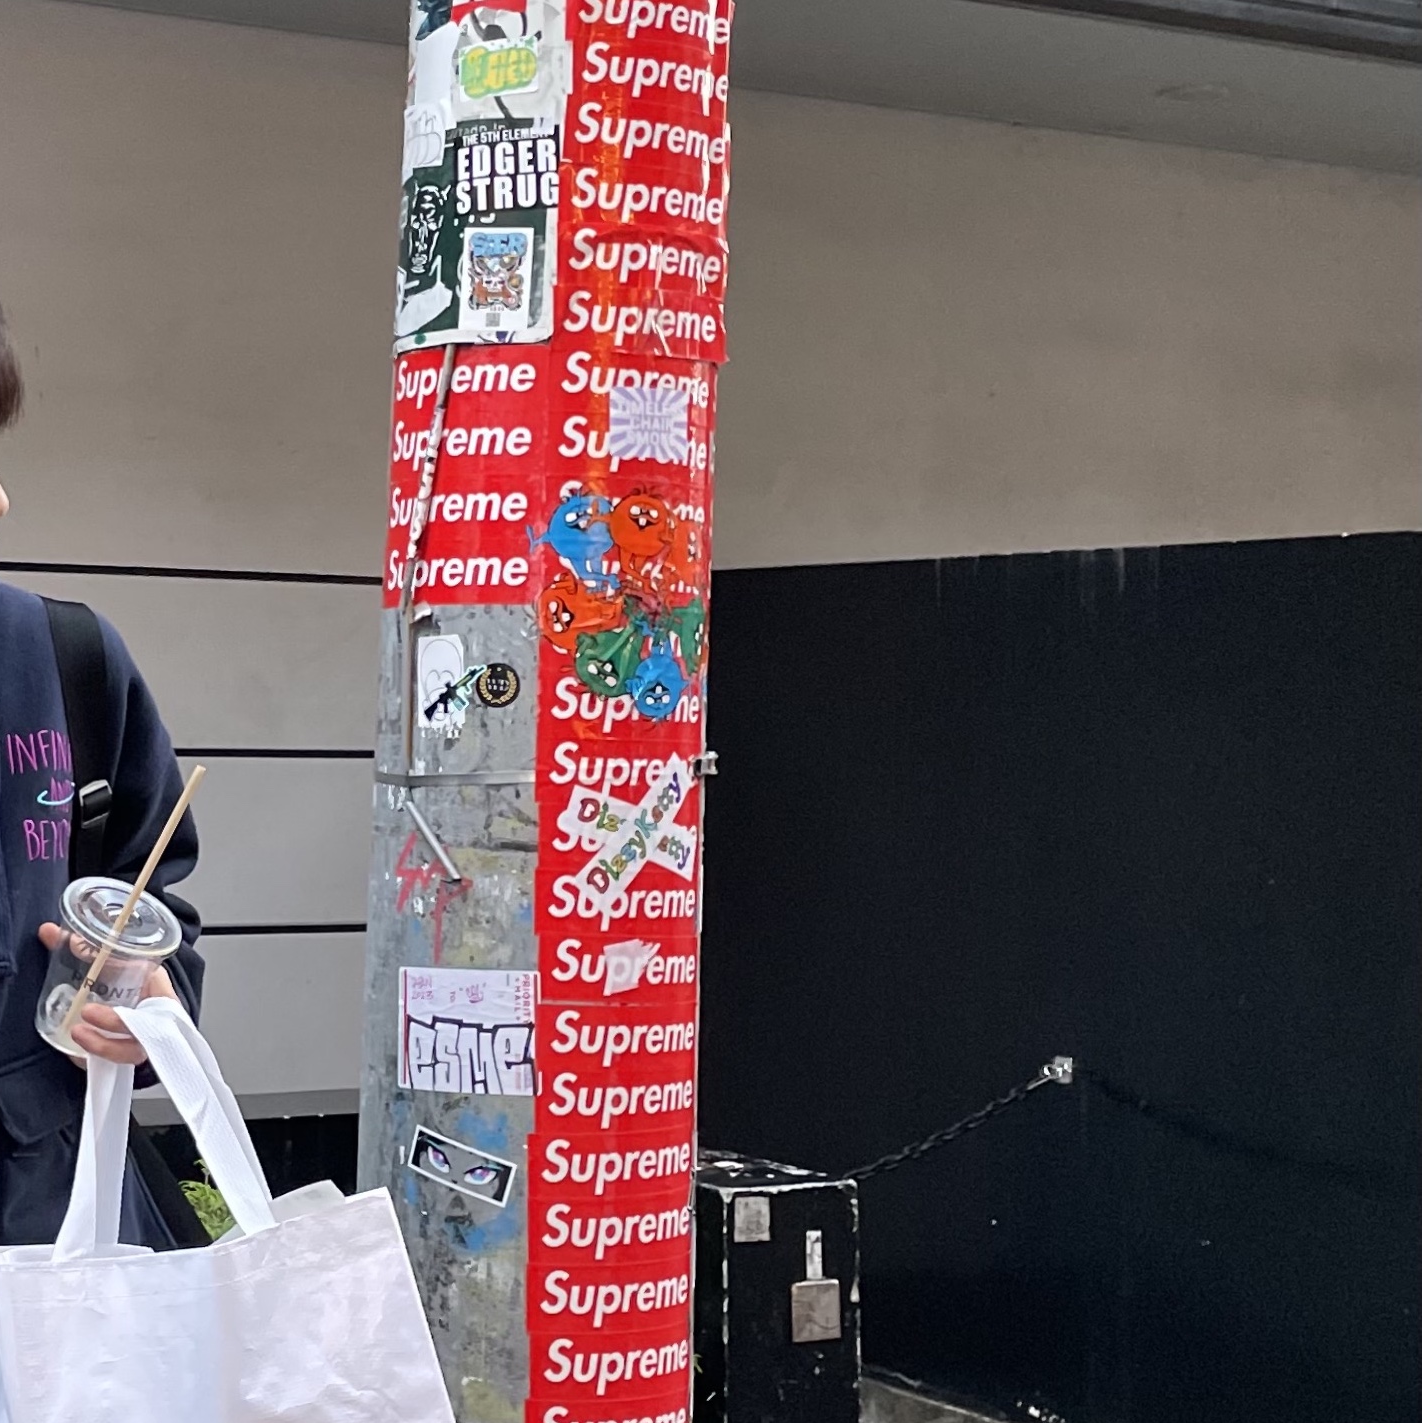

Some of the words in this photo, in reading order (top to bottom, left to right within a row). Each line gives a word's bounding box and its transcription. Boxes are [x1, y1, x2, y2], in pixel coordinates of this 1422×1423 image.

[579, 0, 730, 44] Supreme
[582, 41, 728, 102] Supreme
[457, 138, 558, 181] EDGER
[462, 133, 478, 147] THE
[480, 130, 500, 143] 5TH
[575, 102, 725, 164] Supreme
[456, 171, 560, 215] STRUG
[571, 167, 724, 225] Supreme
[568, 228, 721, 283] Supreme
[563, 290, 717, 346] Supreme
[551, 1010, 695, 1067] Supreme
[548, 1072, 693, 1129] Supreme
[541, 1138, 690, 1195] Supreme
[541, 1203, 689, 1260] Supreme
[540, 1270, 689, 1328] Supreme
[544, 1338, 689, 1396] Supreme
